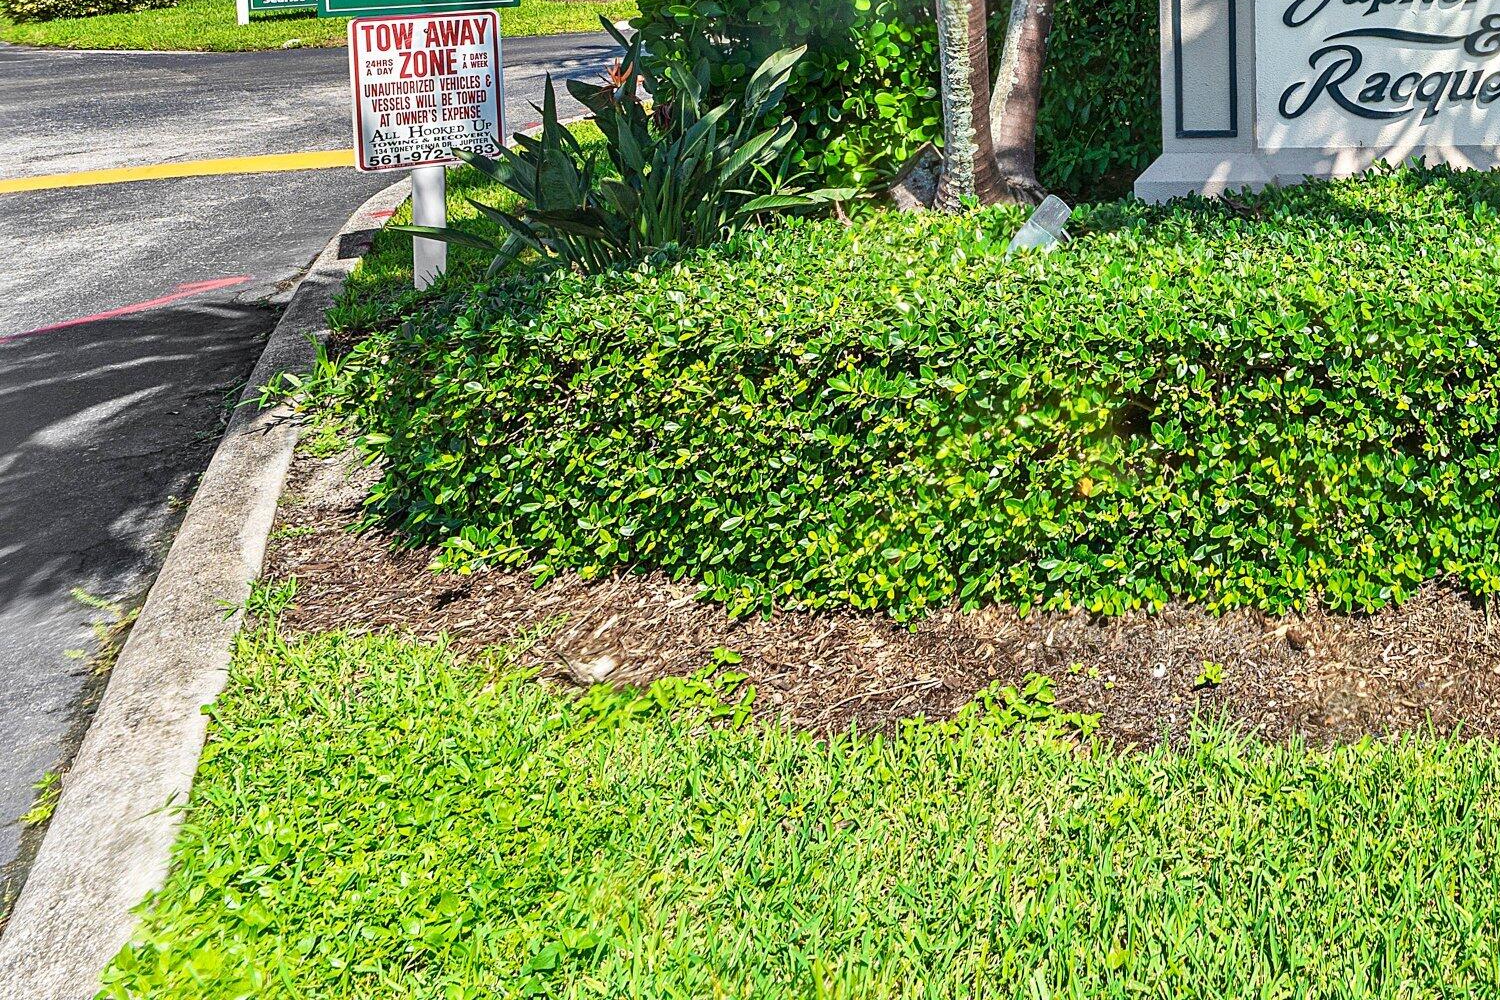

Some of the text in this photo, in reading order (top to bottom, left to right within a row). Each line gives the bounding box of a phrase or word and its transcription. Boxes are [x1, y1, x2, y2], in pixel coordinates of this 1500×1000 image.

[361, 18, 488, 53] TOW AWAY
[366, 59, 394, 68] 24HRS
[399, 49, 457, 78] ZONE
[470, 52, 488, 61] DAYS
[470, 60, 488, 68] WEEK
[377, 67, 394, 76] DAY
[364, 74, 492, 98] UNAUTHORIZED VEHICLES &
[371, 89, 487, 113] VESSELS WILL BE TOWED
[380, 105, 482, 127] AT OWNER'S EXPENSE
[371, 138, 419, 148] TOWING
[434, 131, 491, 141] RECOVERY
[460, 137, 489, 146] JUPITER
